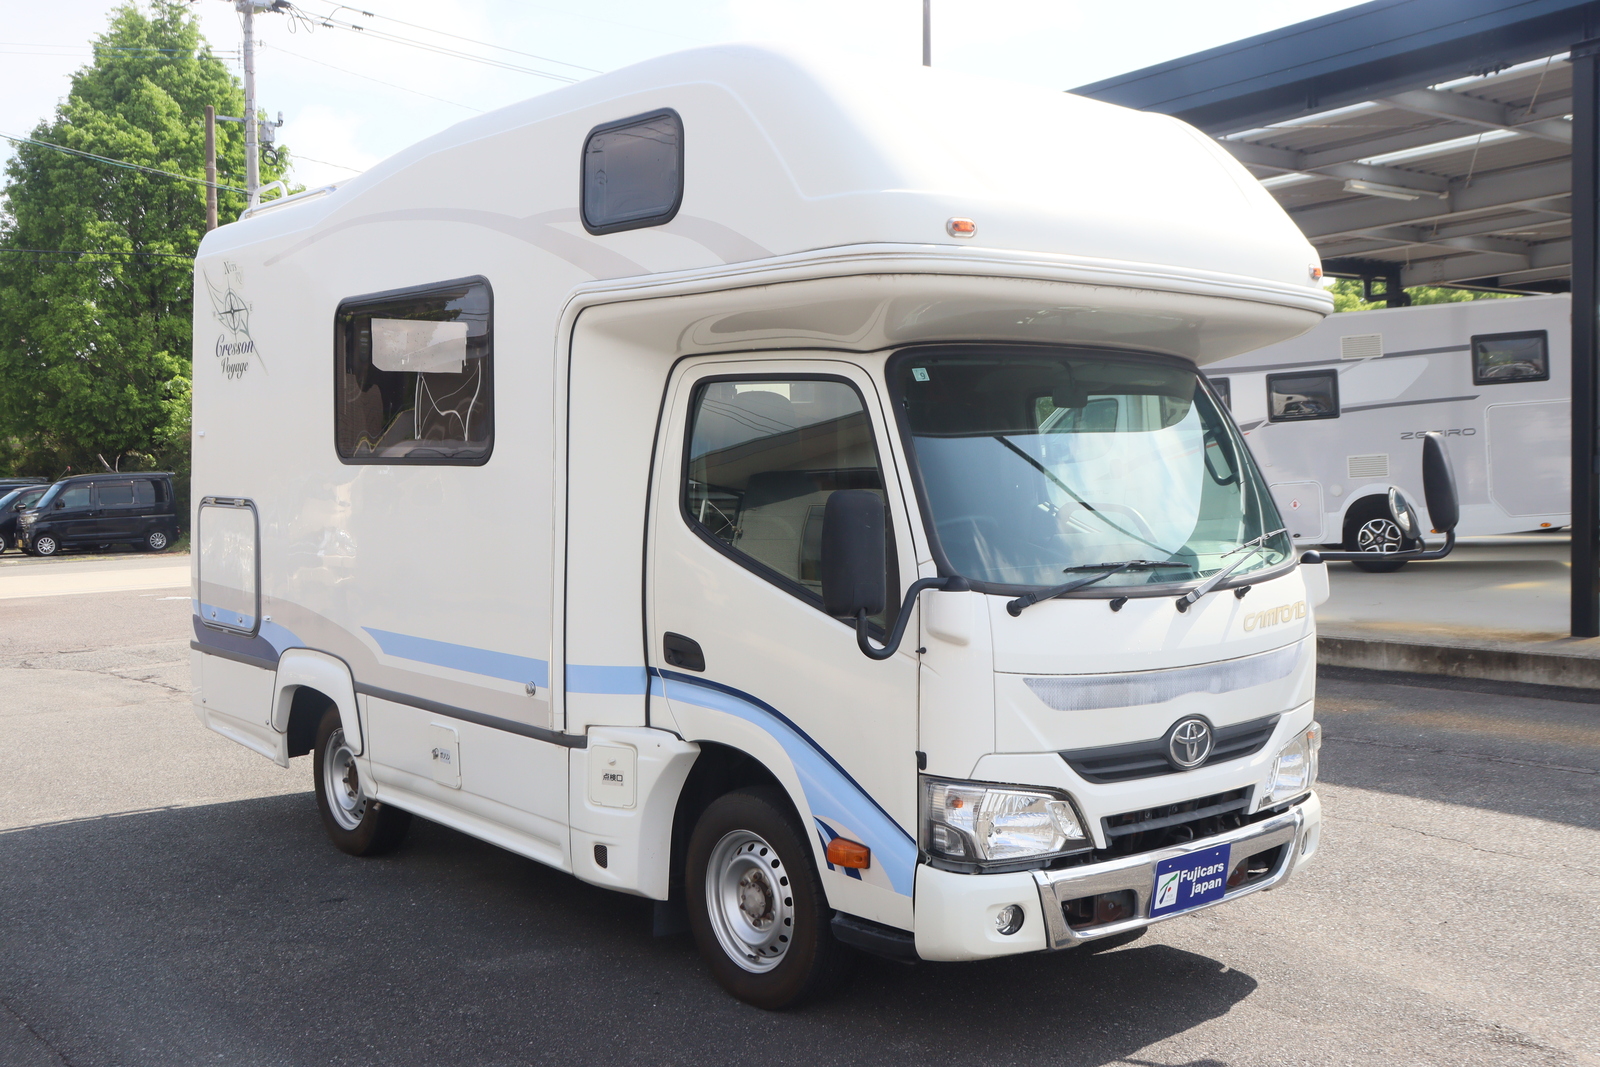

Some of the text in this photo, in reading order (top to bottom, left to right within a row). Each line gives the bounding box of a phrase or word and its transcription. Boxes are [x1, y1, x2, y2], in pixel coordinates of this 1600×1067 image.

[602, 772, 624, 783] 点検口
[1179, 862, 1225, 883] Fujicars
[1189, 878, 1222, 898] japan
